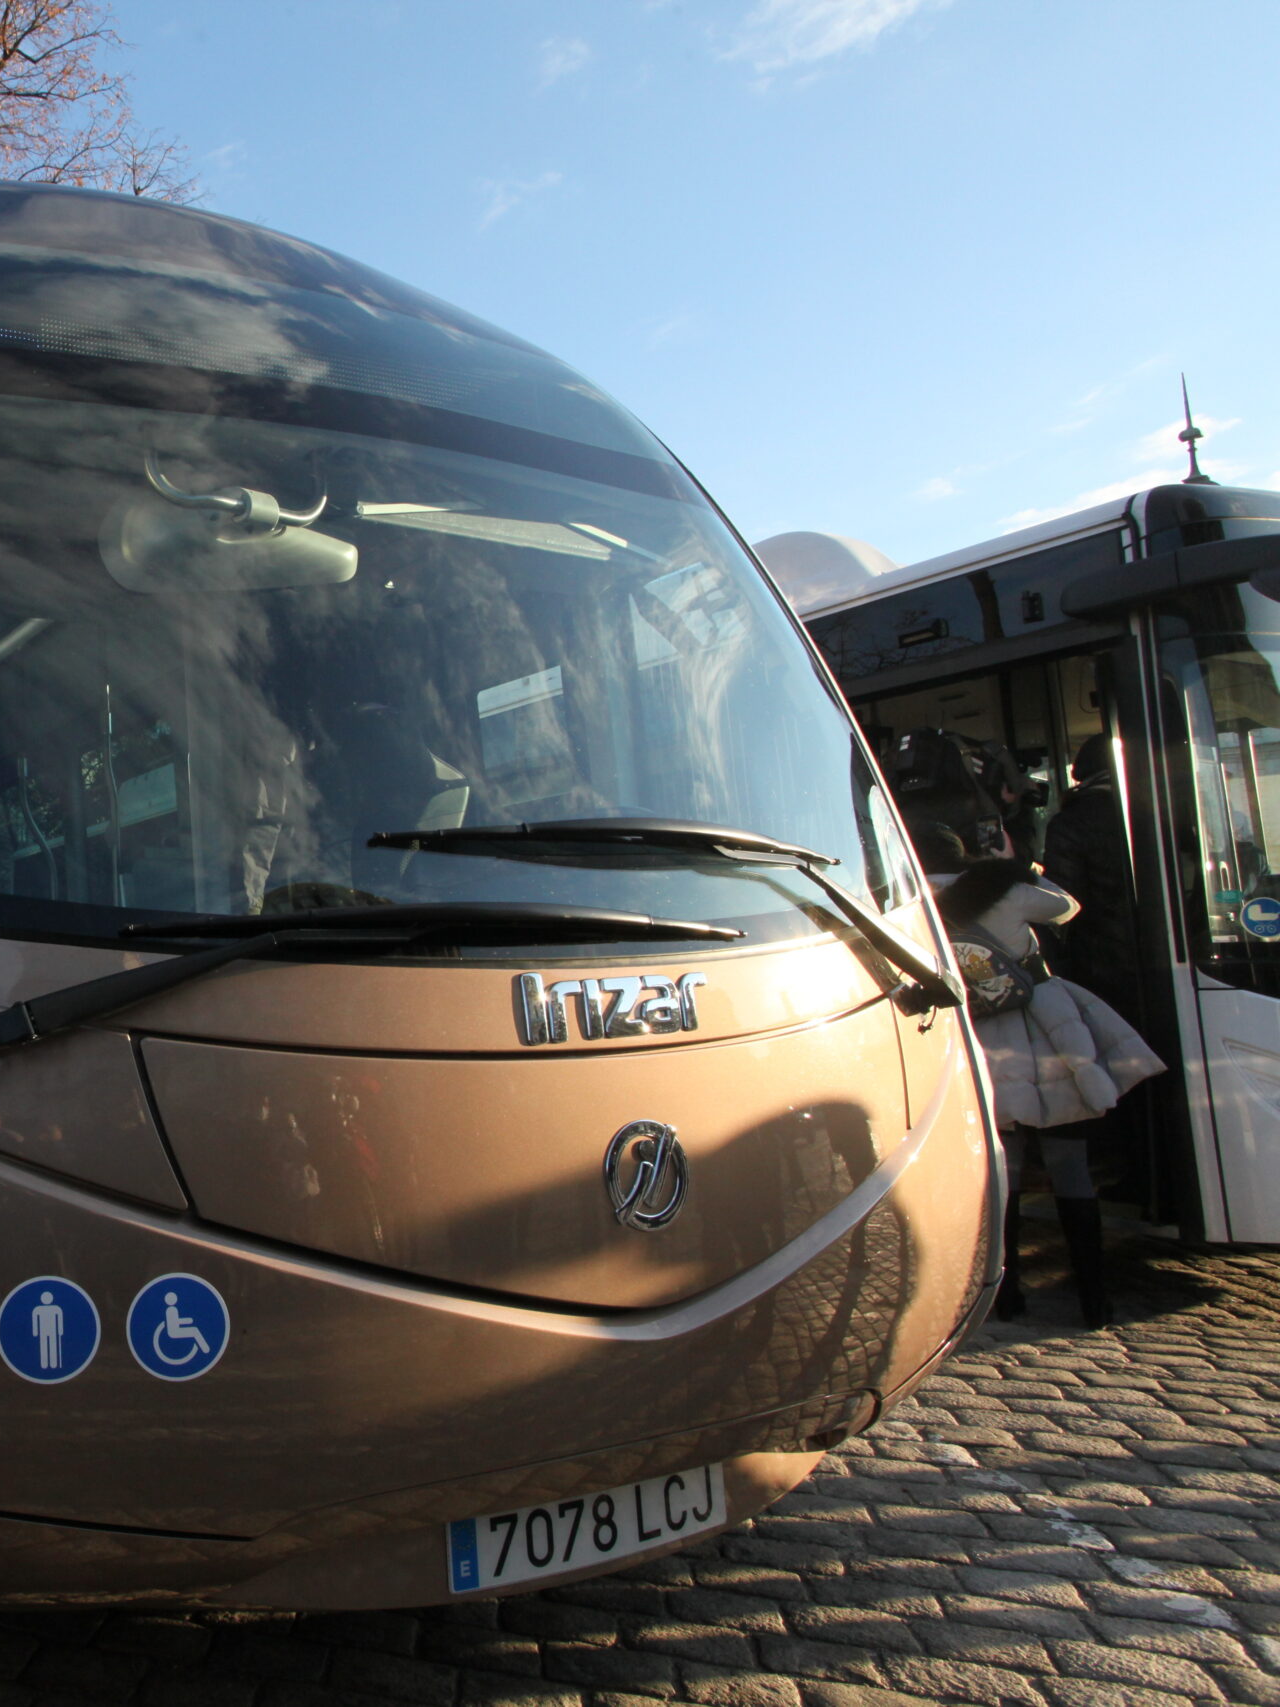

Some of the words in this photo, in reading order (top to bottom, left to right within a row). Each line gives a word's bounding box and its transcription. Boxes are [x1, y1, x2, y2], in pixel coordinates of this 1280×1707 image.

[519, 972, 707, 1046] Irizar
[489, 1494, 618, 1577] 7078
[635, 1465, 713, 1542] LCJ
[460, 1560, 471, 1577] E
